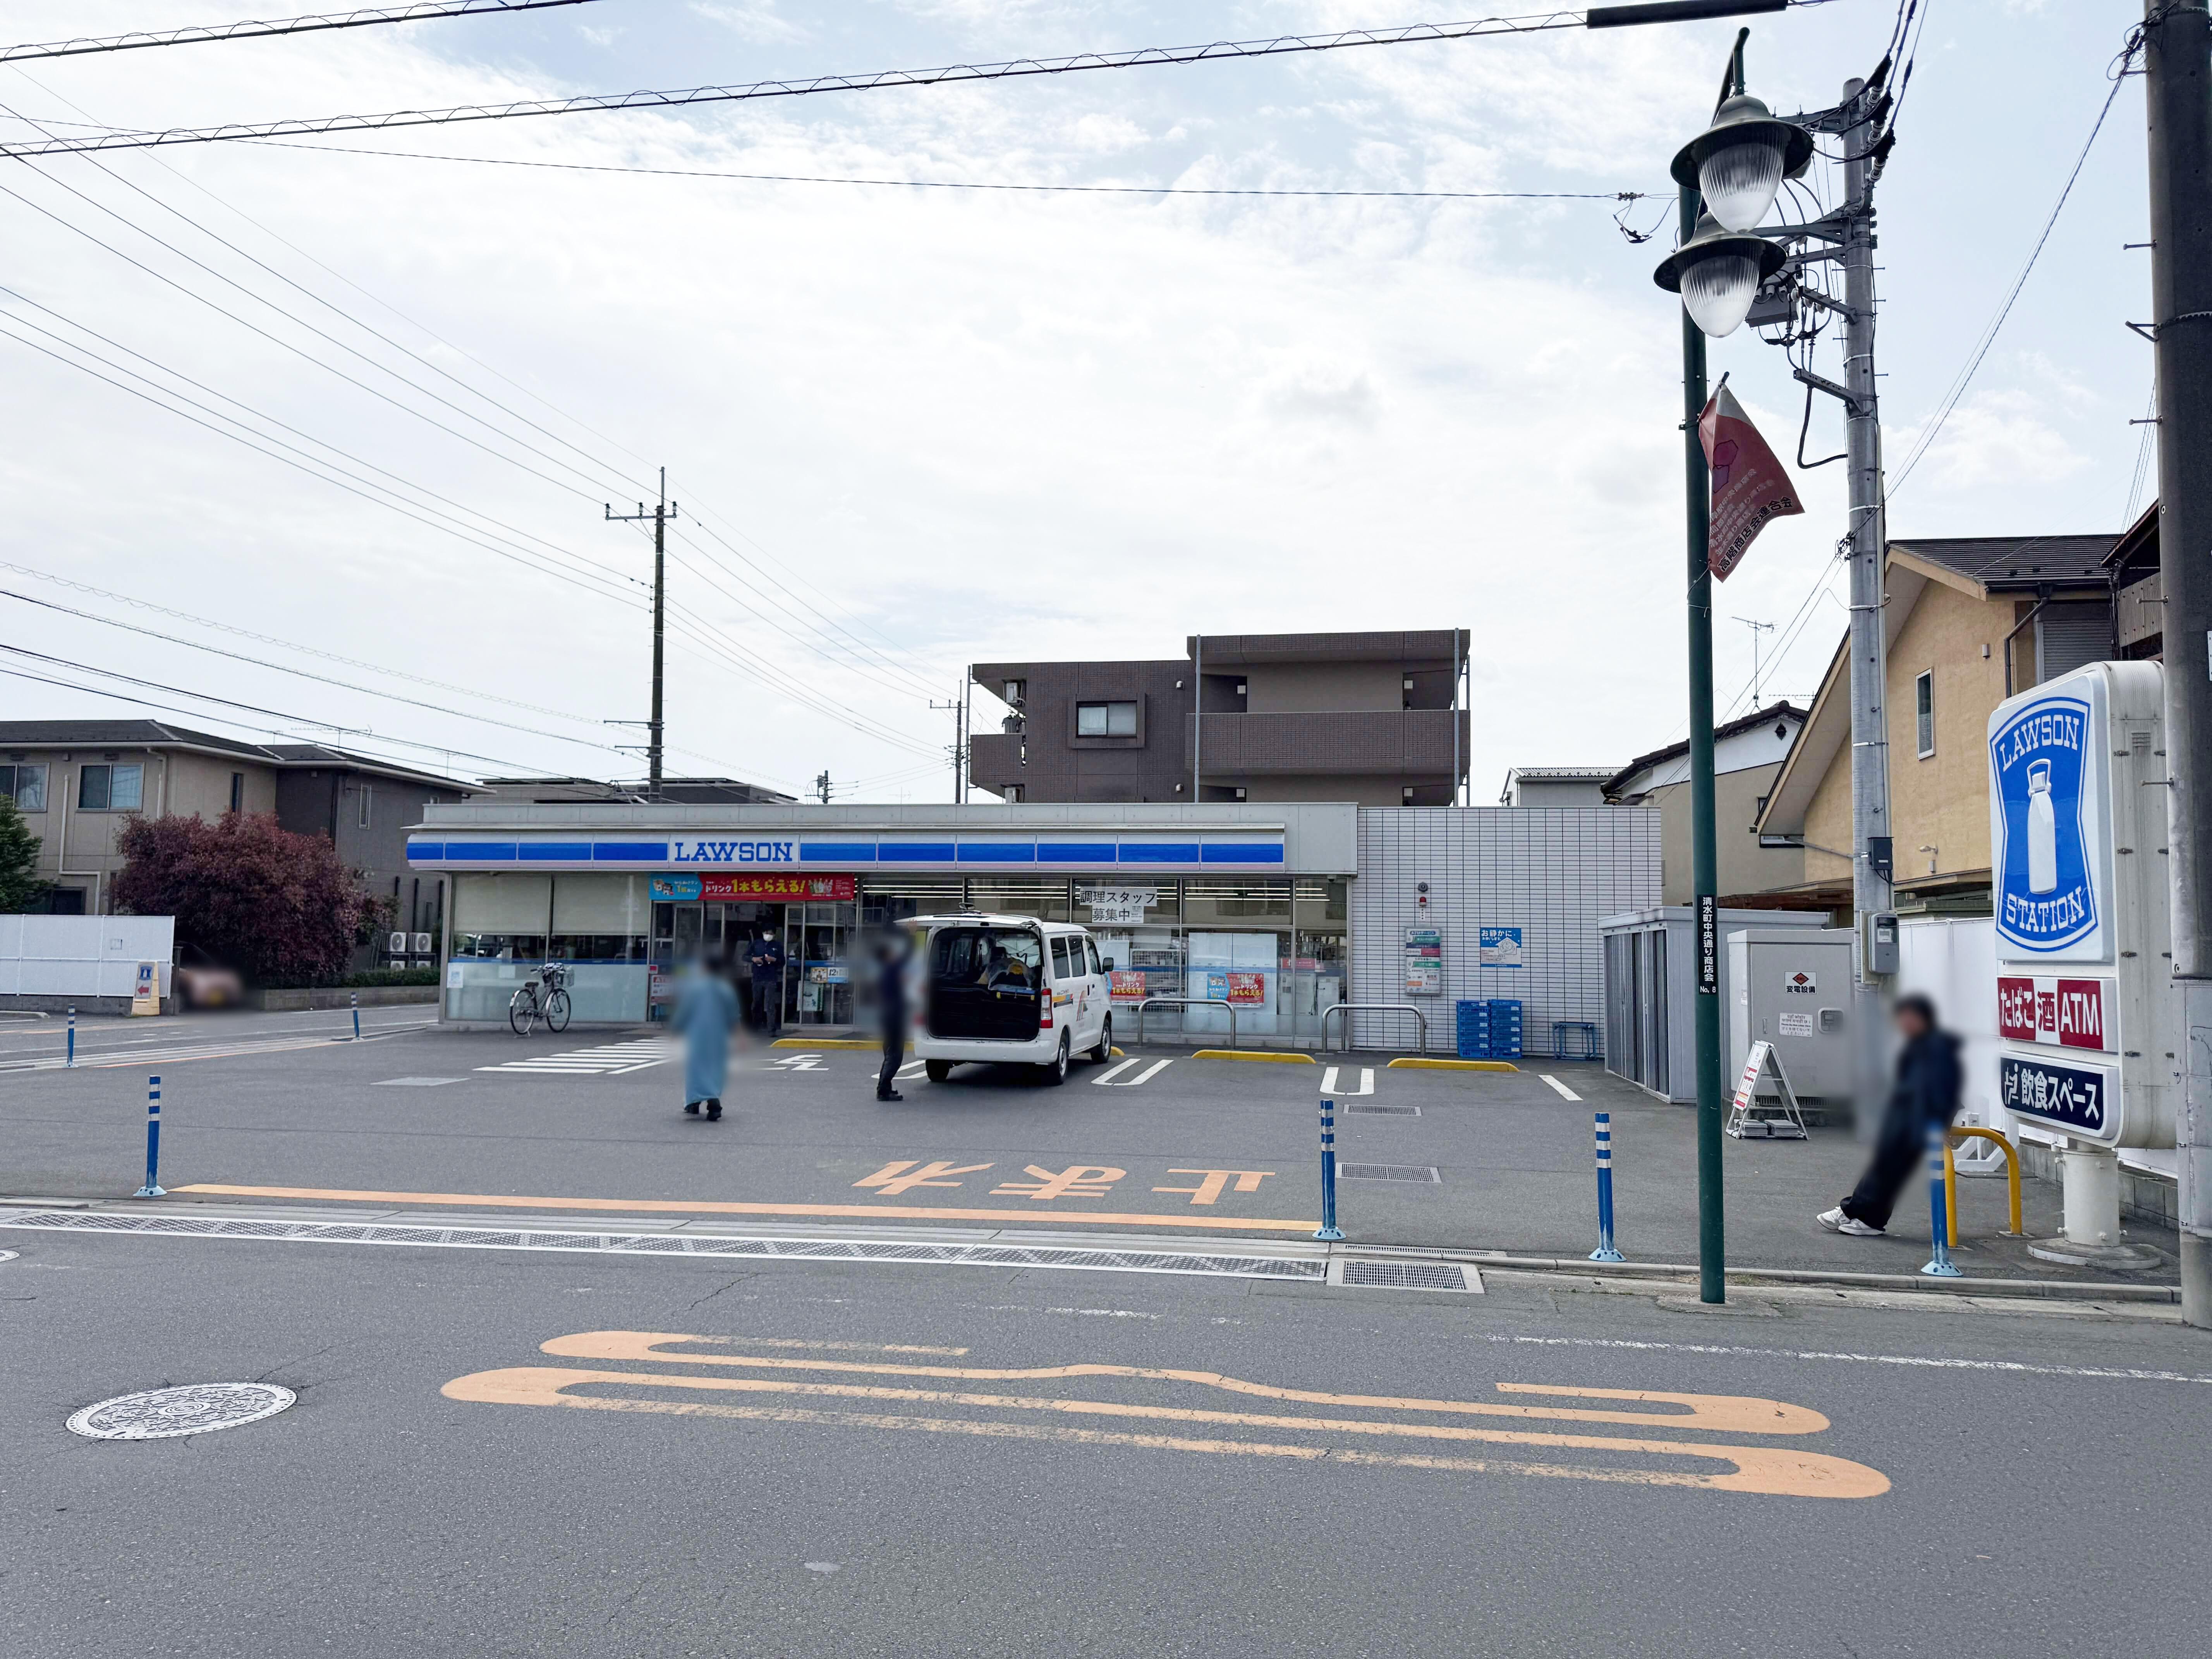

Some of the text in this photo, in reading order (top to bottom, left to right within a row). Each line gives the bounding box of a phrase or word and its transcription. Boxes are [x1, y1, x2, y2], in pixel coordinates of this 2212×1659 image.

[1717, 496, 1793, 572] 高階商店会連合会
[2000, 714, 2079, 771] LAWSON
[675, 842, 793, 862] LAWSON
[706, 884, 732, 893] ドリンク
[1080, 891, 1156, 903] 調理スタッフ
[2006, 885, 2085, 933] STATION
[1093, 908, 1130, 921] 募集中
[1703, 897, 1714, 982] 清水町中央通り商店会
[2001, 986, 2100, 1036] たばこ 酒 ATM
[2021, 1068, 2099, 1120] 飲食スペース
[852, 1160, 1275, 1205] 止まれ
